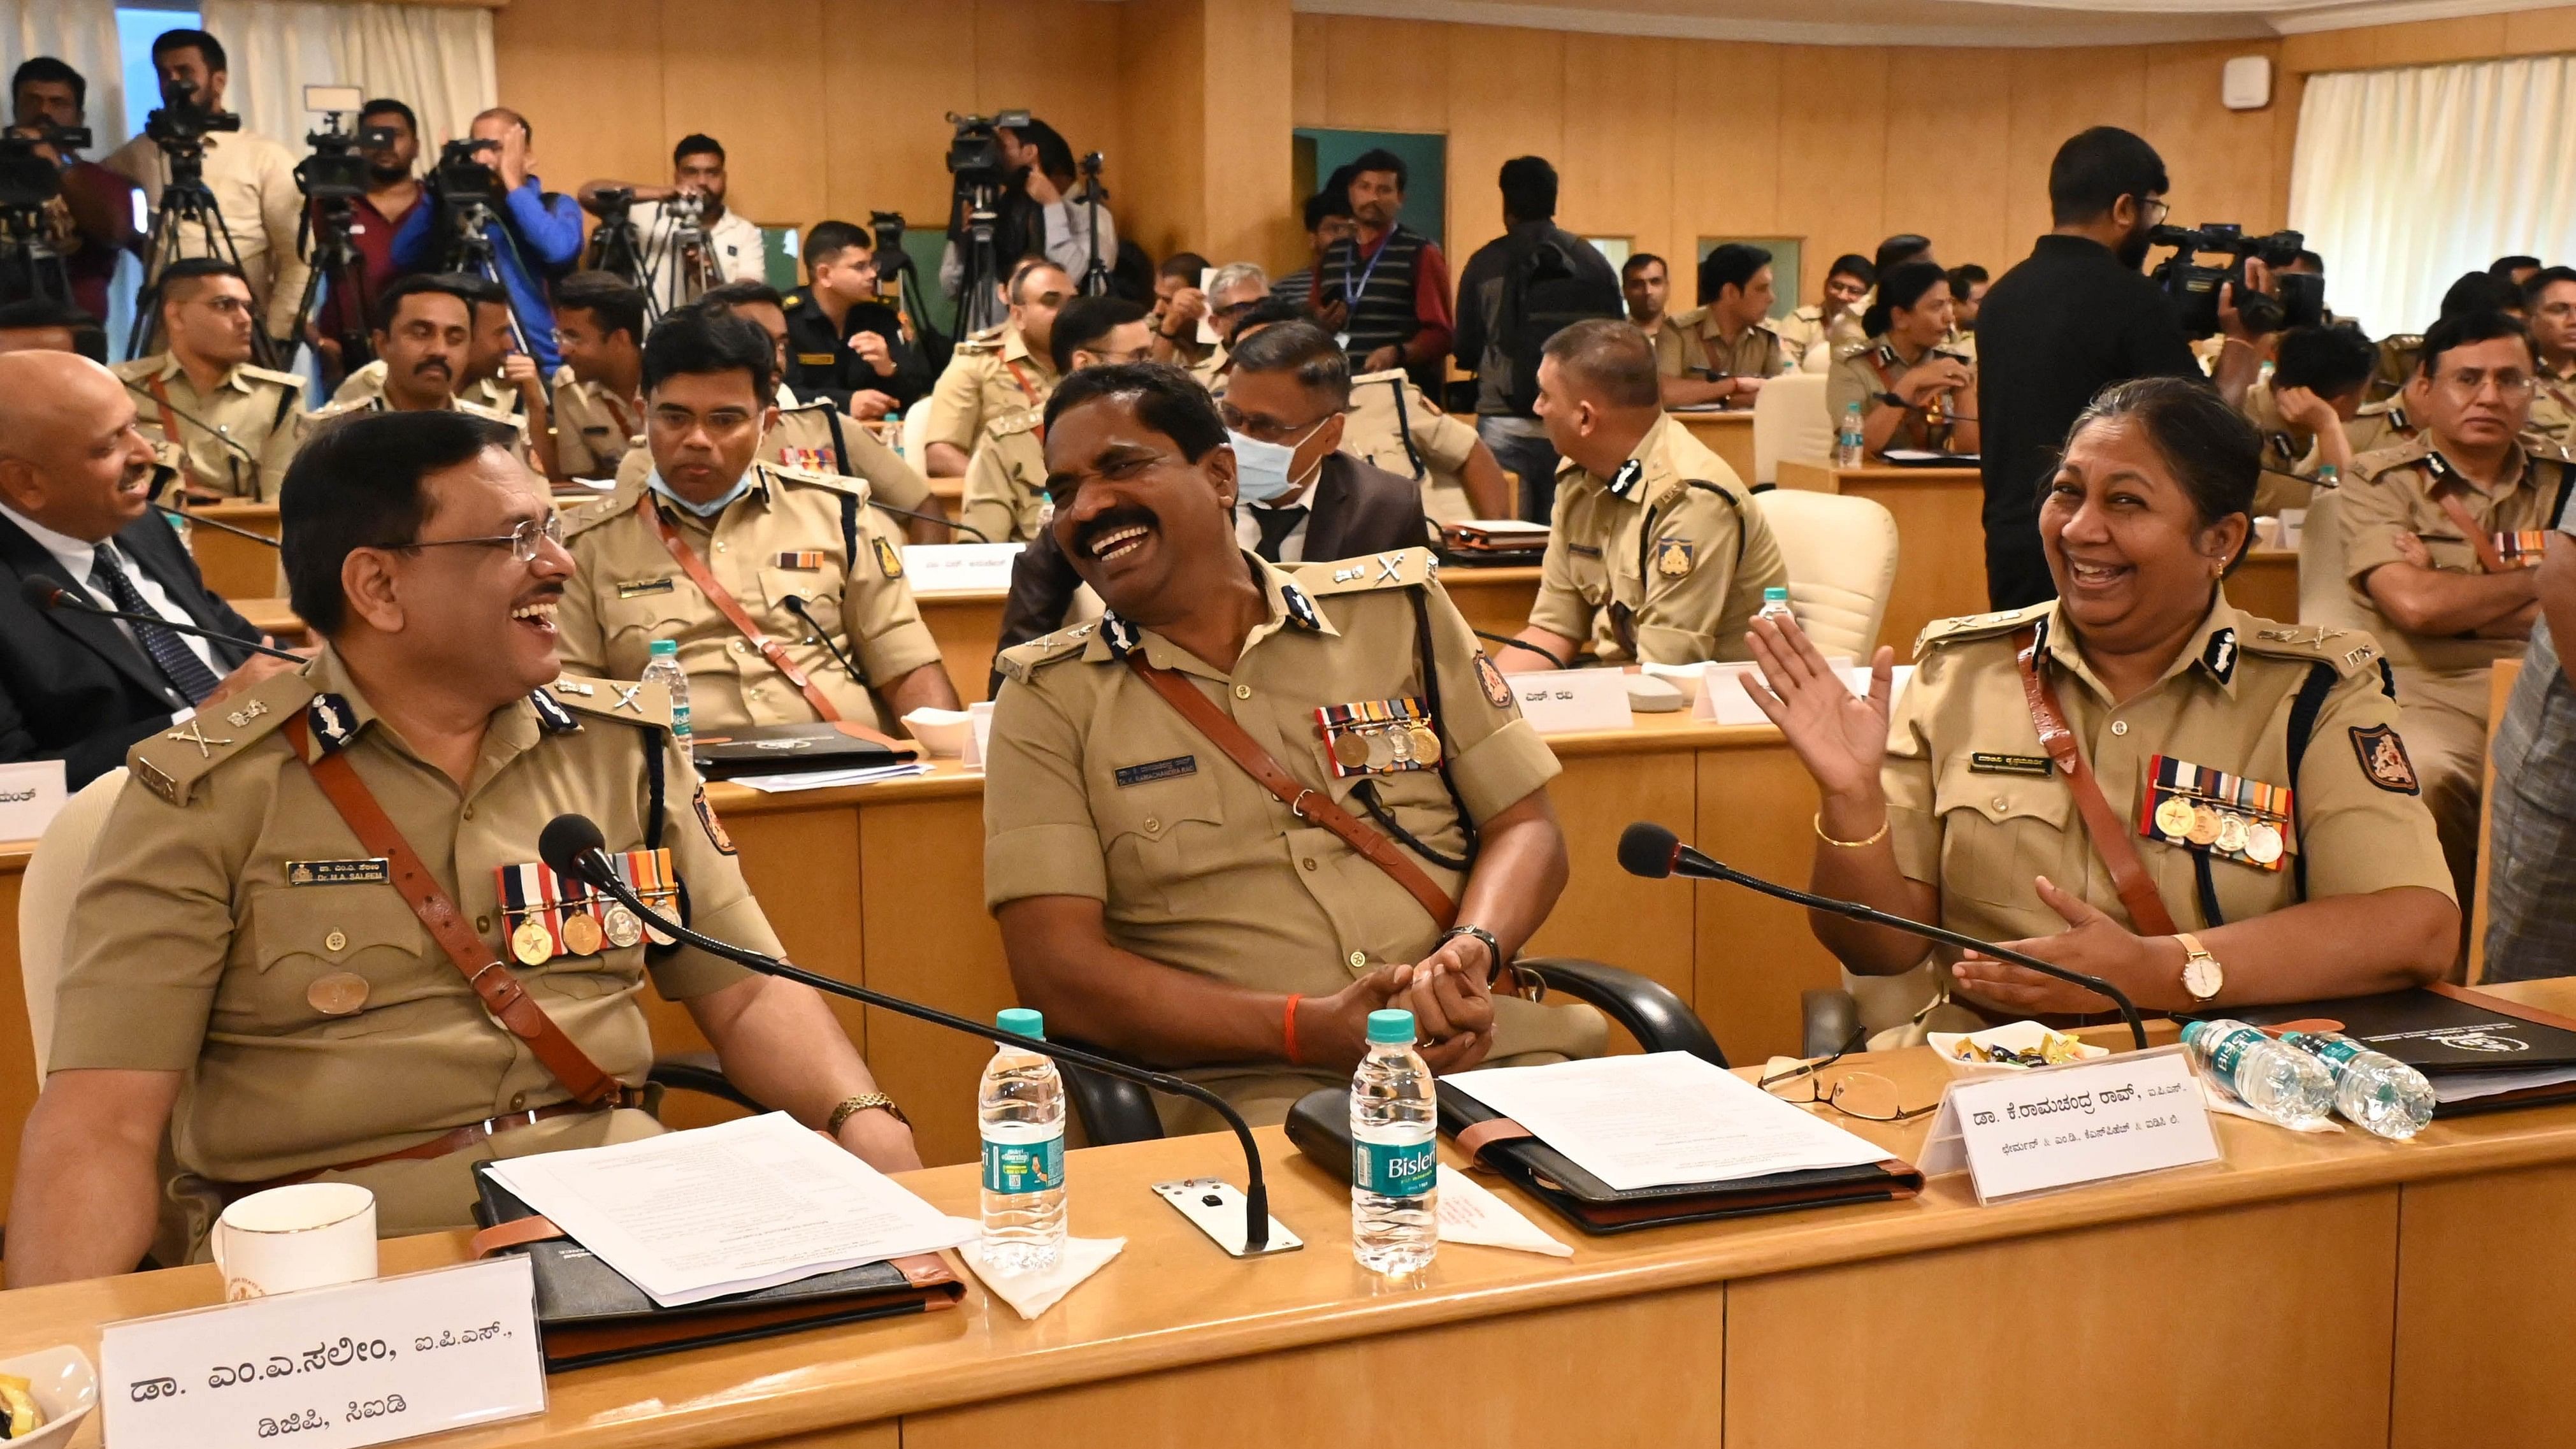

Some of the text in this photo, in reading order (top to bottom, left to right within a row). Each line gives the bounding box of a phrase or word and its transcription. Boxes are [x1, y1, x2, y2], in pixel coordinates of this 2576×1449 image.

[1973, 1111, 2000, 1125] ಡಾ.
[2099, 1083, 2142, 1104] ರಾವ್,
[131, 1376, 186, 1402] ಡಾ.
[208, 1336, 397, 1388] ಎಂ.ಎ.ಸಲೀಂ,
[257, 1393, 407, 1439] ಡಿಜಿಪಿ, ಸಿಐಡಿ
